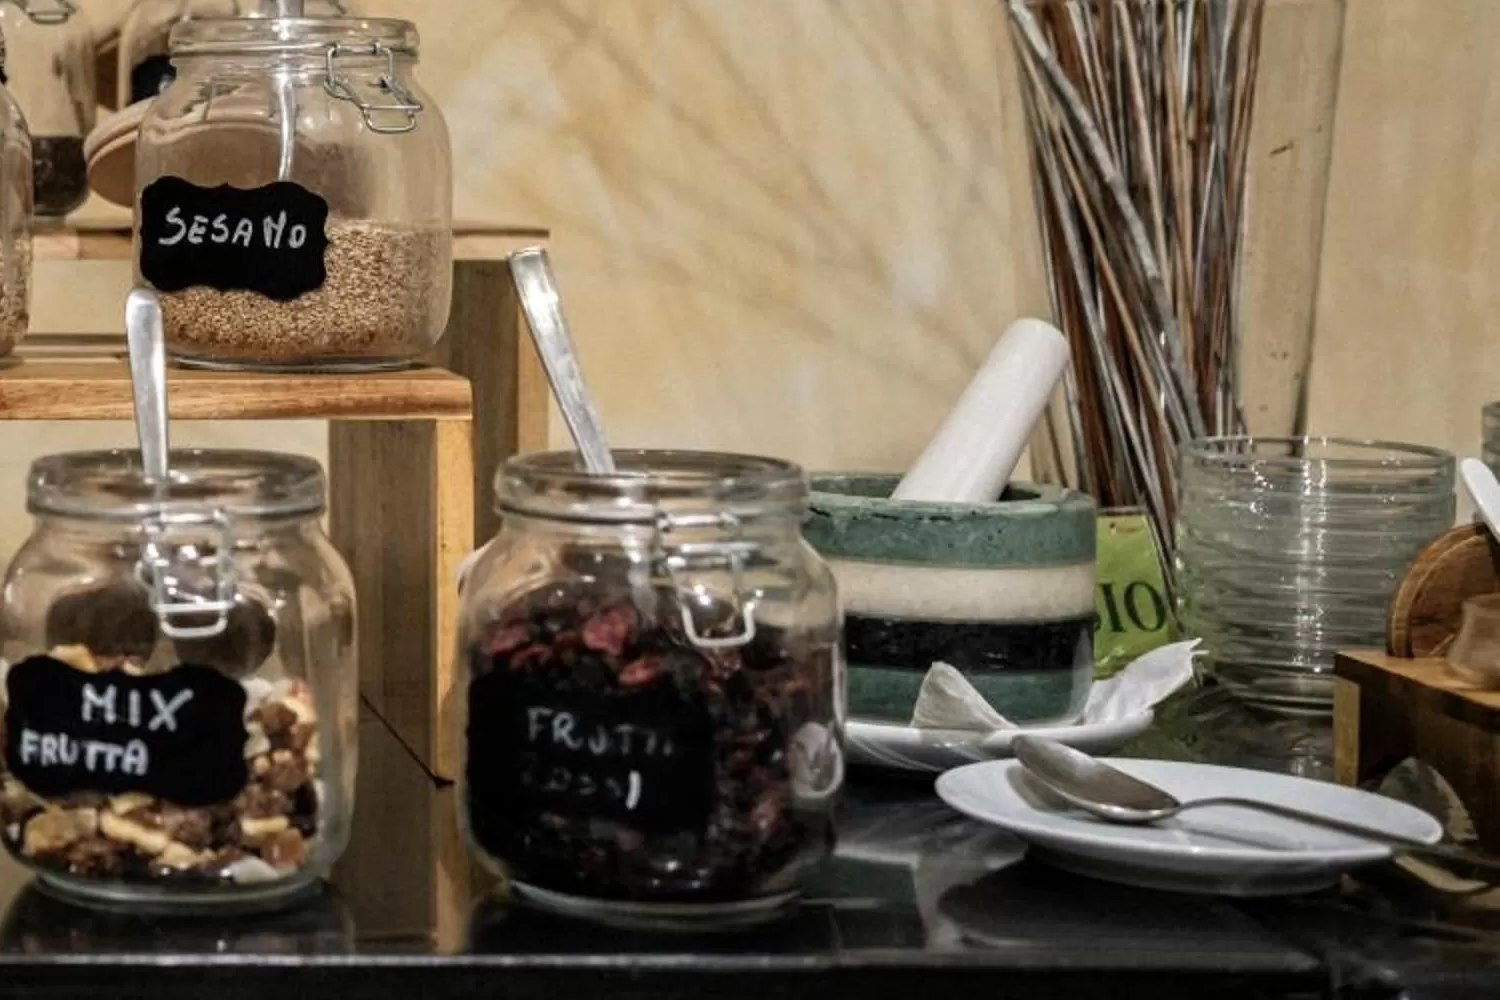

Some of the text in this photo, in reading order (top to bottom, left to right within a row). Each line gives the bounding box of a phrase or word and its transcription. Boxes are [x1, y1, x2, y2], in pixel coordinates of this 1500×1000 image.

[1095, 579, 1168, 634] IO
[81, 682, 195, 732] MIX
[19, 728, 150, 776] FRUTTA
